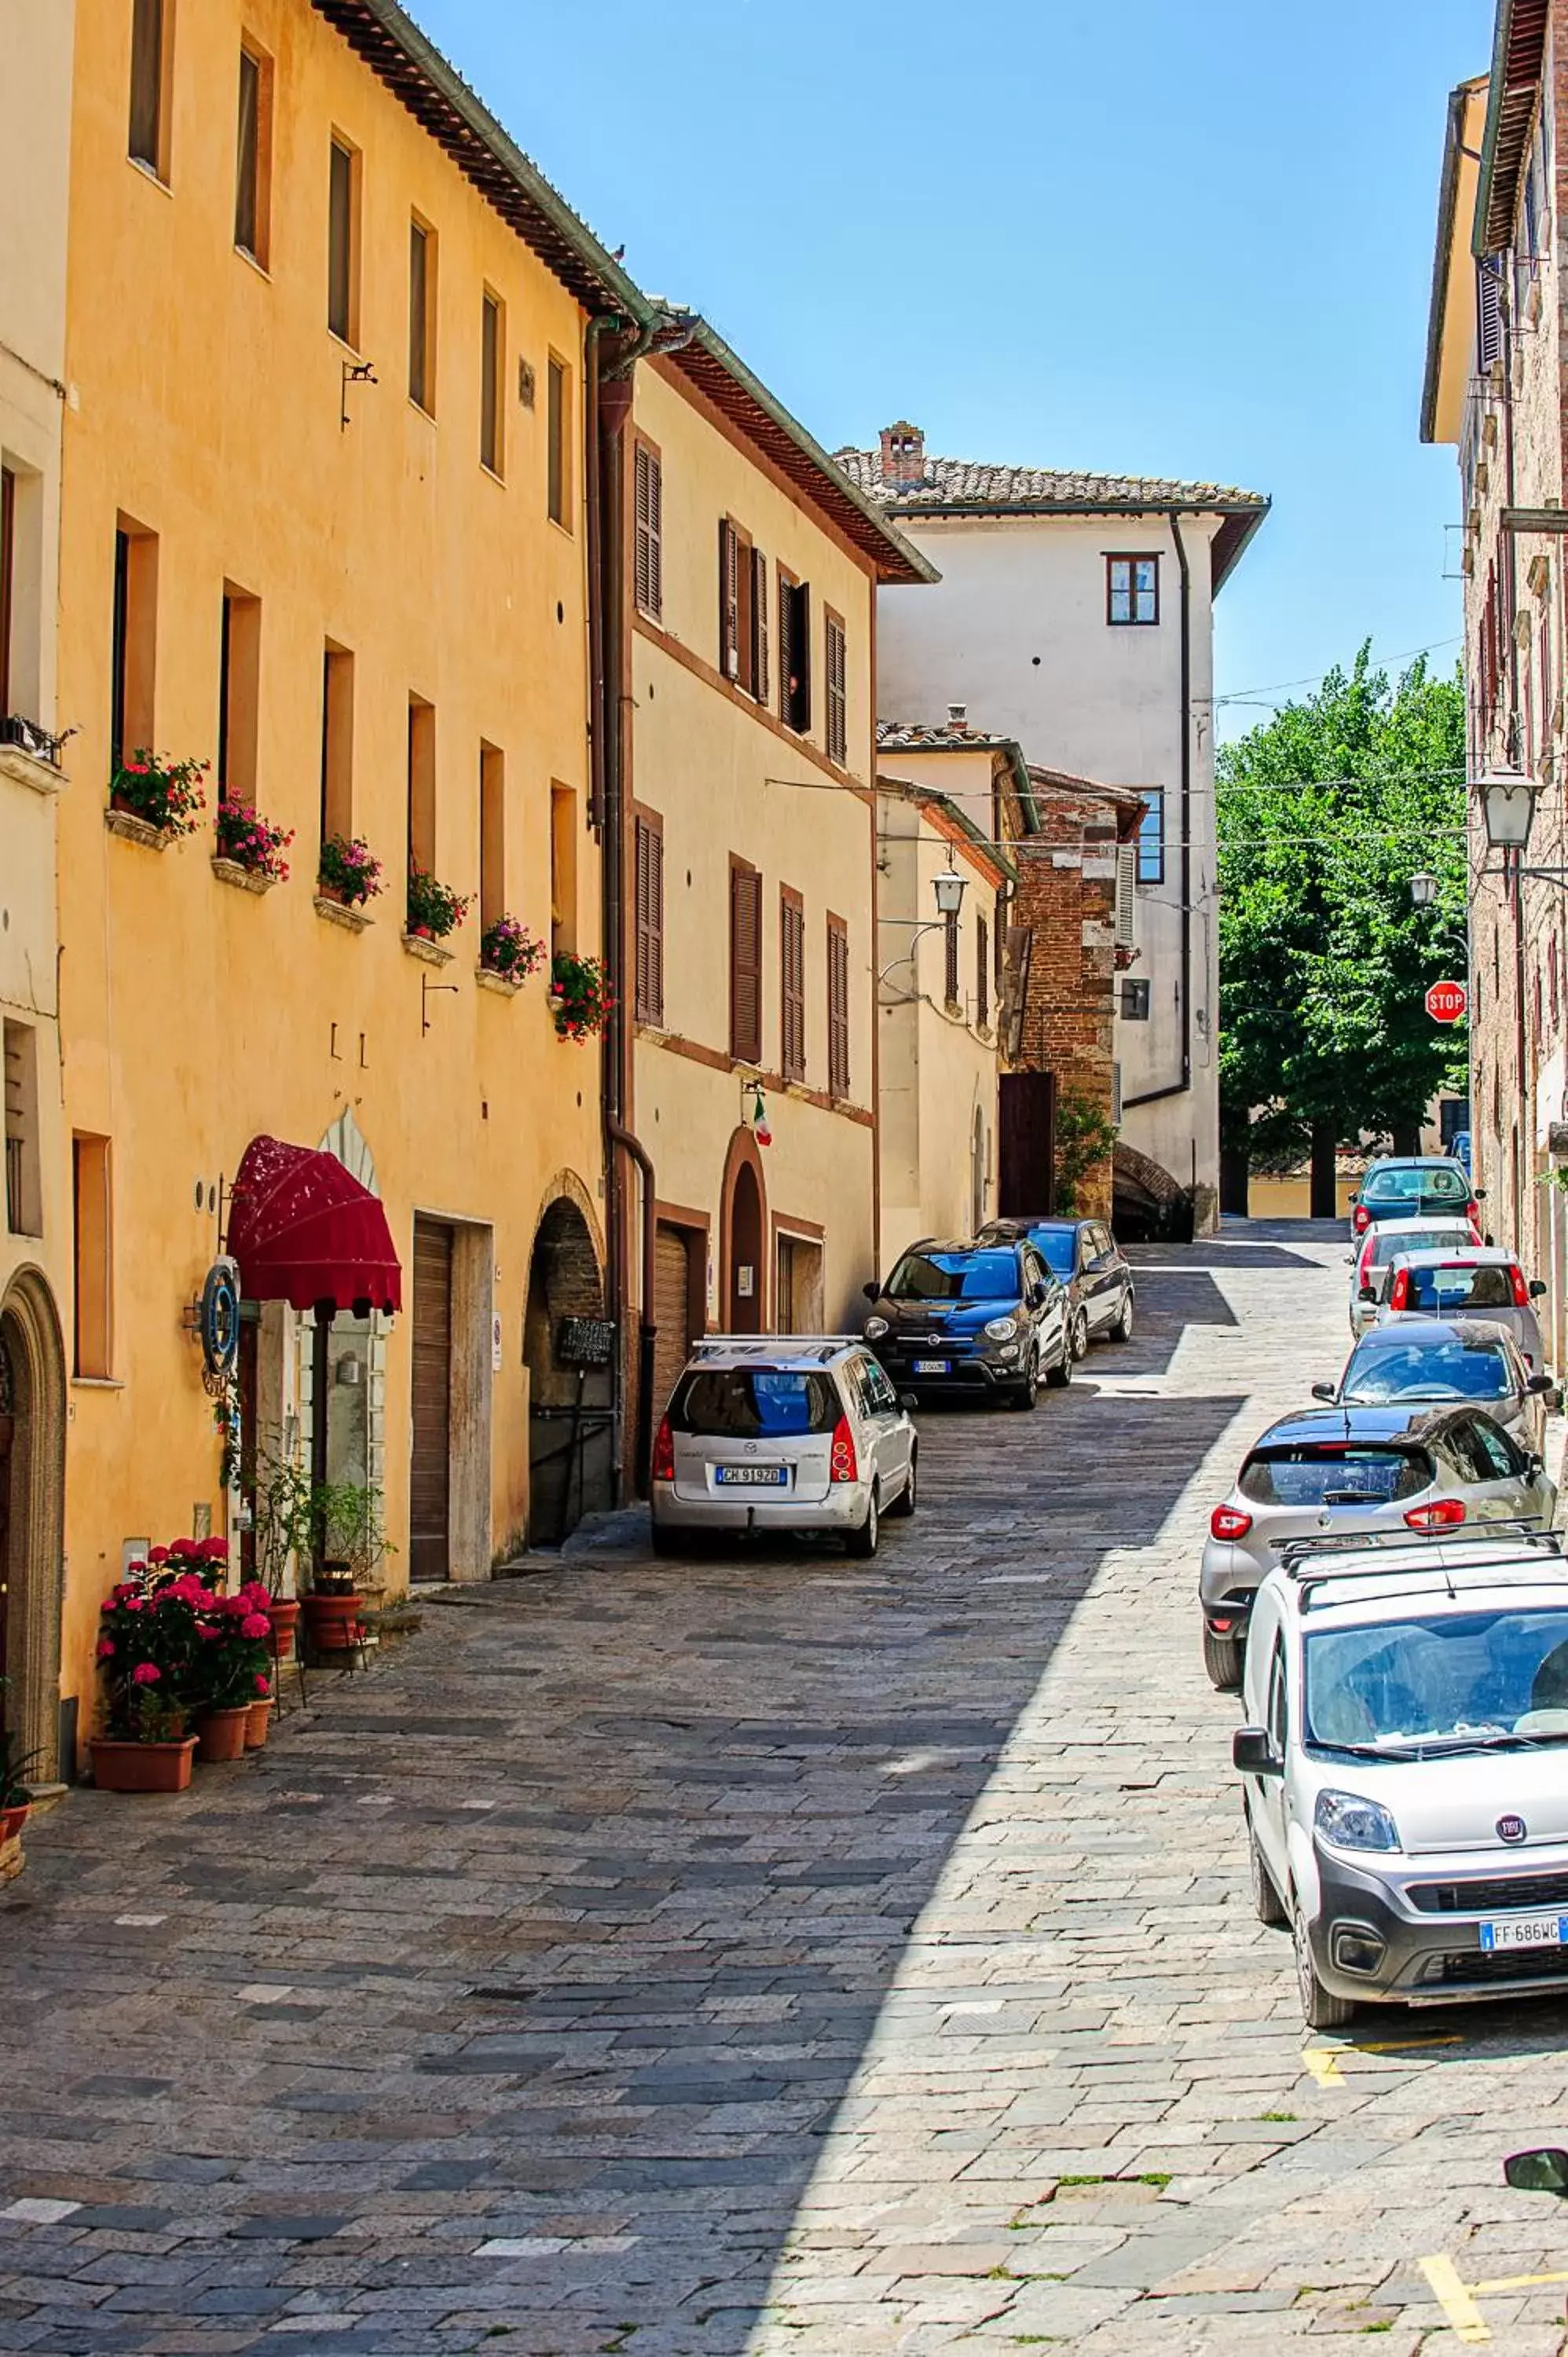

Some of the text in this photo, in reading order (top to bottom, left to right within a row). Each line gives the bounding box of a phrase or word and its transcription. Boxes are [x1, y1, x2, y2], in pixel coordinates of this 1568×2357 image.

[1430, 994, 1463, 1010] STOP
[724, 1470, 739, 1481] CH
[1495, 1926, 1511, 1943] FF
